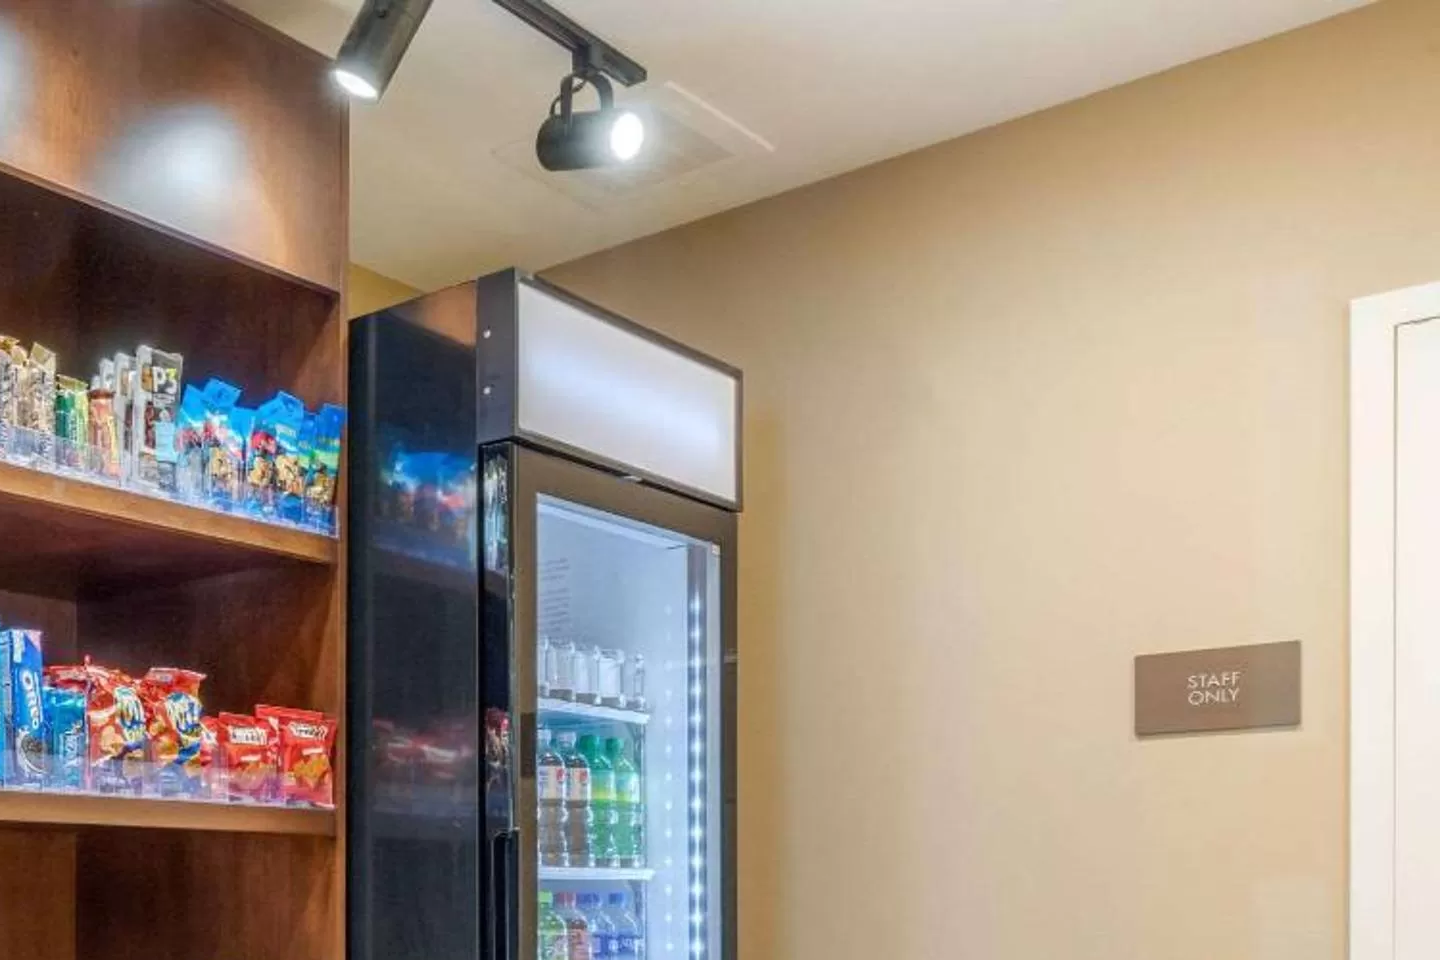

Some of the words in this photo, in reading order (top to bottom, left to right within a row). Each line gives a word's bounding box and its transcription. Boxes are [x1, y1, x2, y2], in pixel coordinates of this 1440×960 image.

[152, 366, 178, 395] P3
[1187, 671, 1241, 689] STAFF
[20, 669, 42, 730] OREO
[1187, 687, 1241, 706] ONLY
